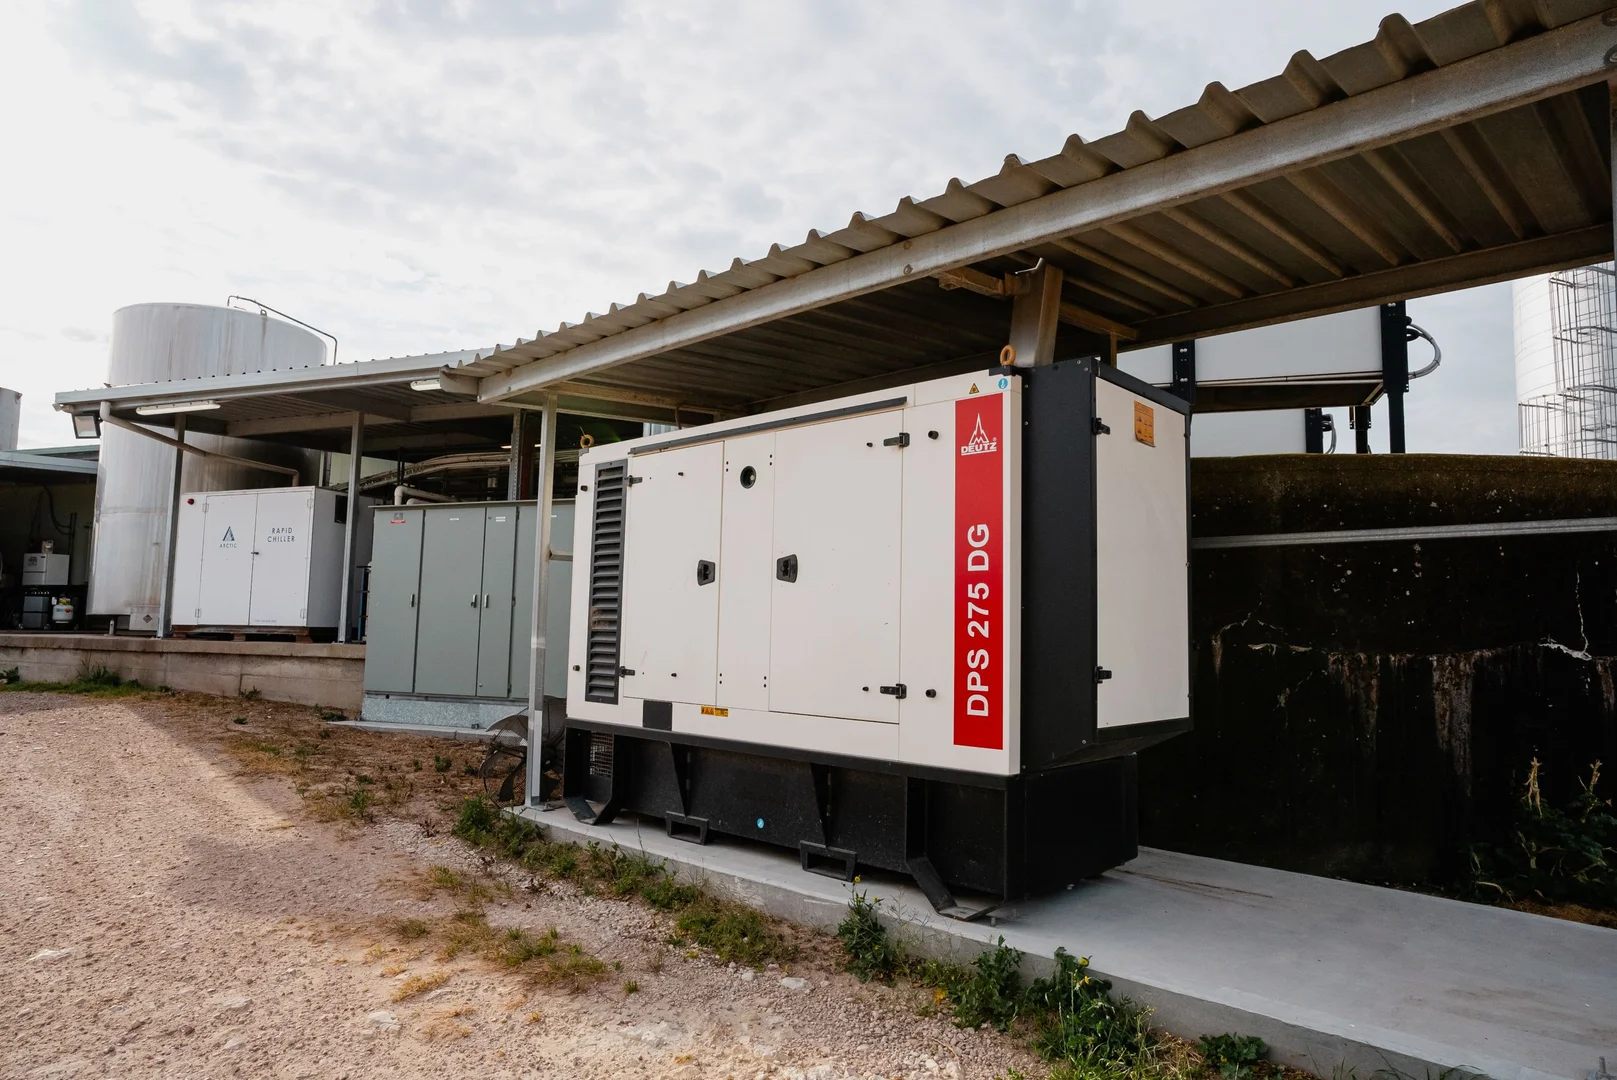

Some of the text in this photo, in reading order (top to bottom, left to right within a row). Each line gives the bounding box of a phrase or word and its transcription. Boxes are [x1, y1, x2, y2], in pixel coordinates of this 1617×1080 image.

[960, 442, 997, 454] DEUTZ
[271, 527, 293, 535] RAPID
[267, 535, 295, 543] CHILLER
[967, 523, 990, 717] DPS 275 DG
